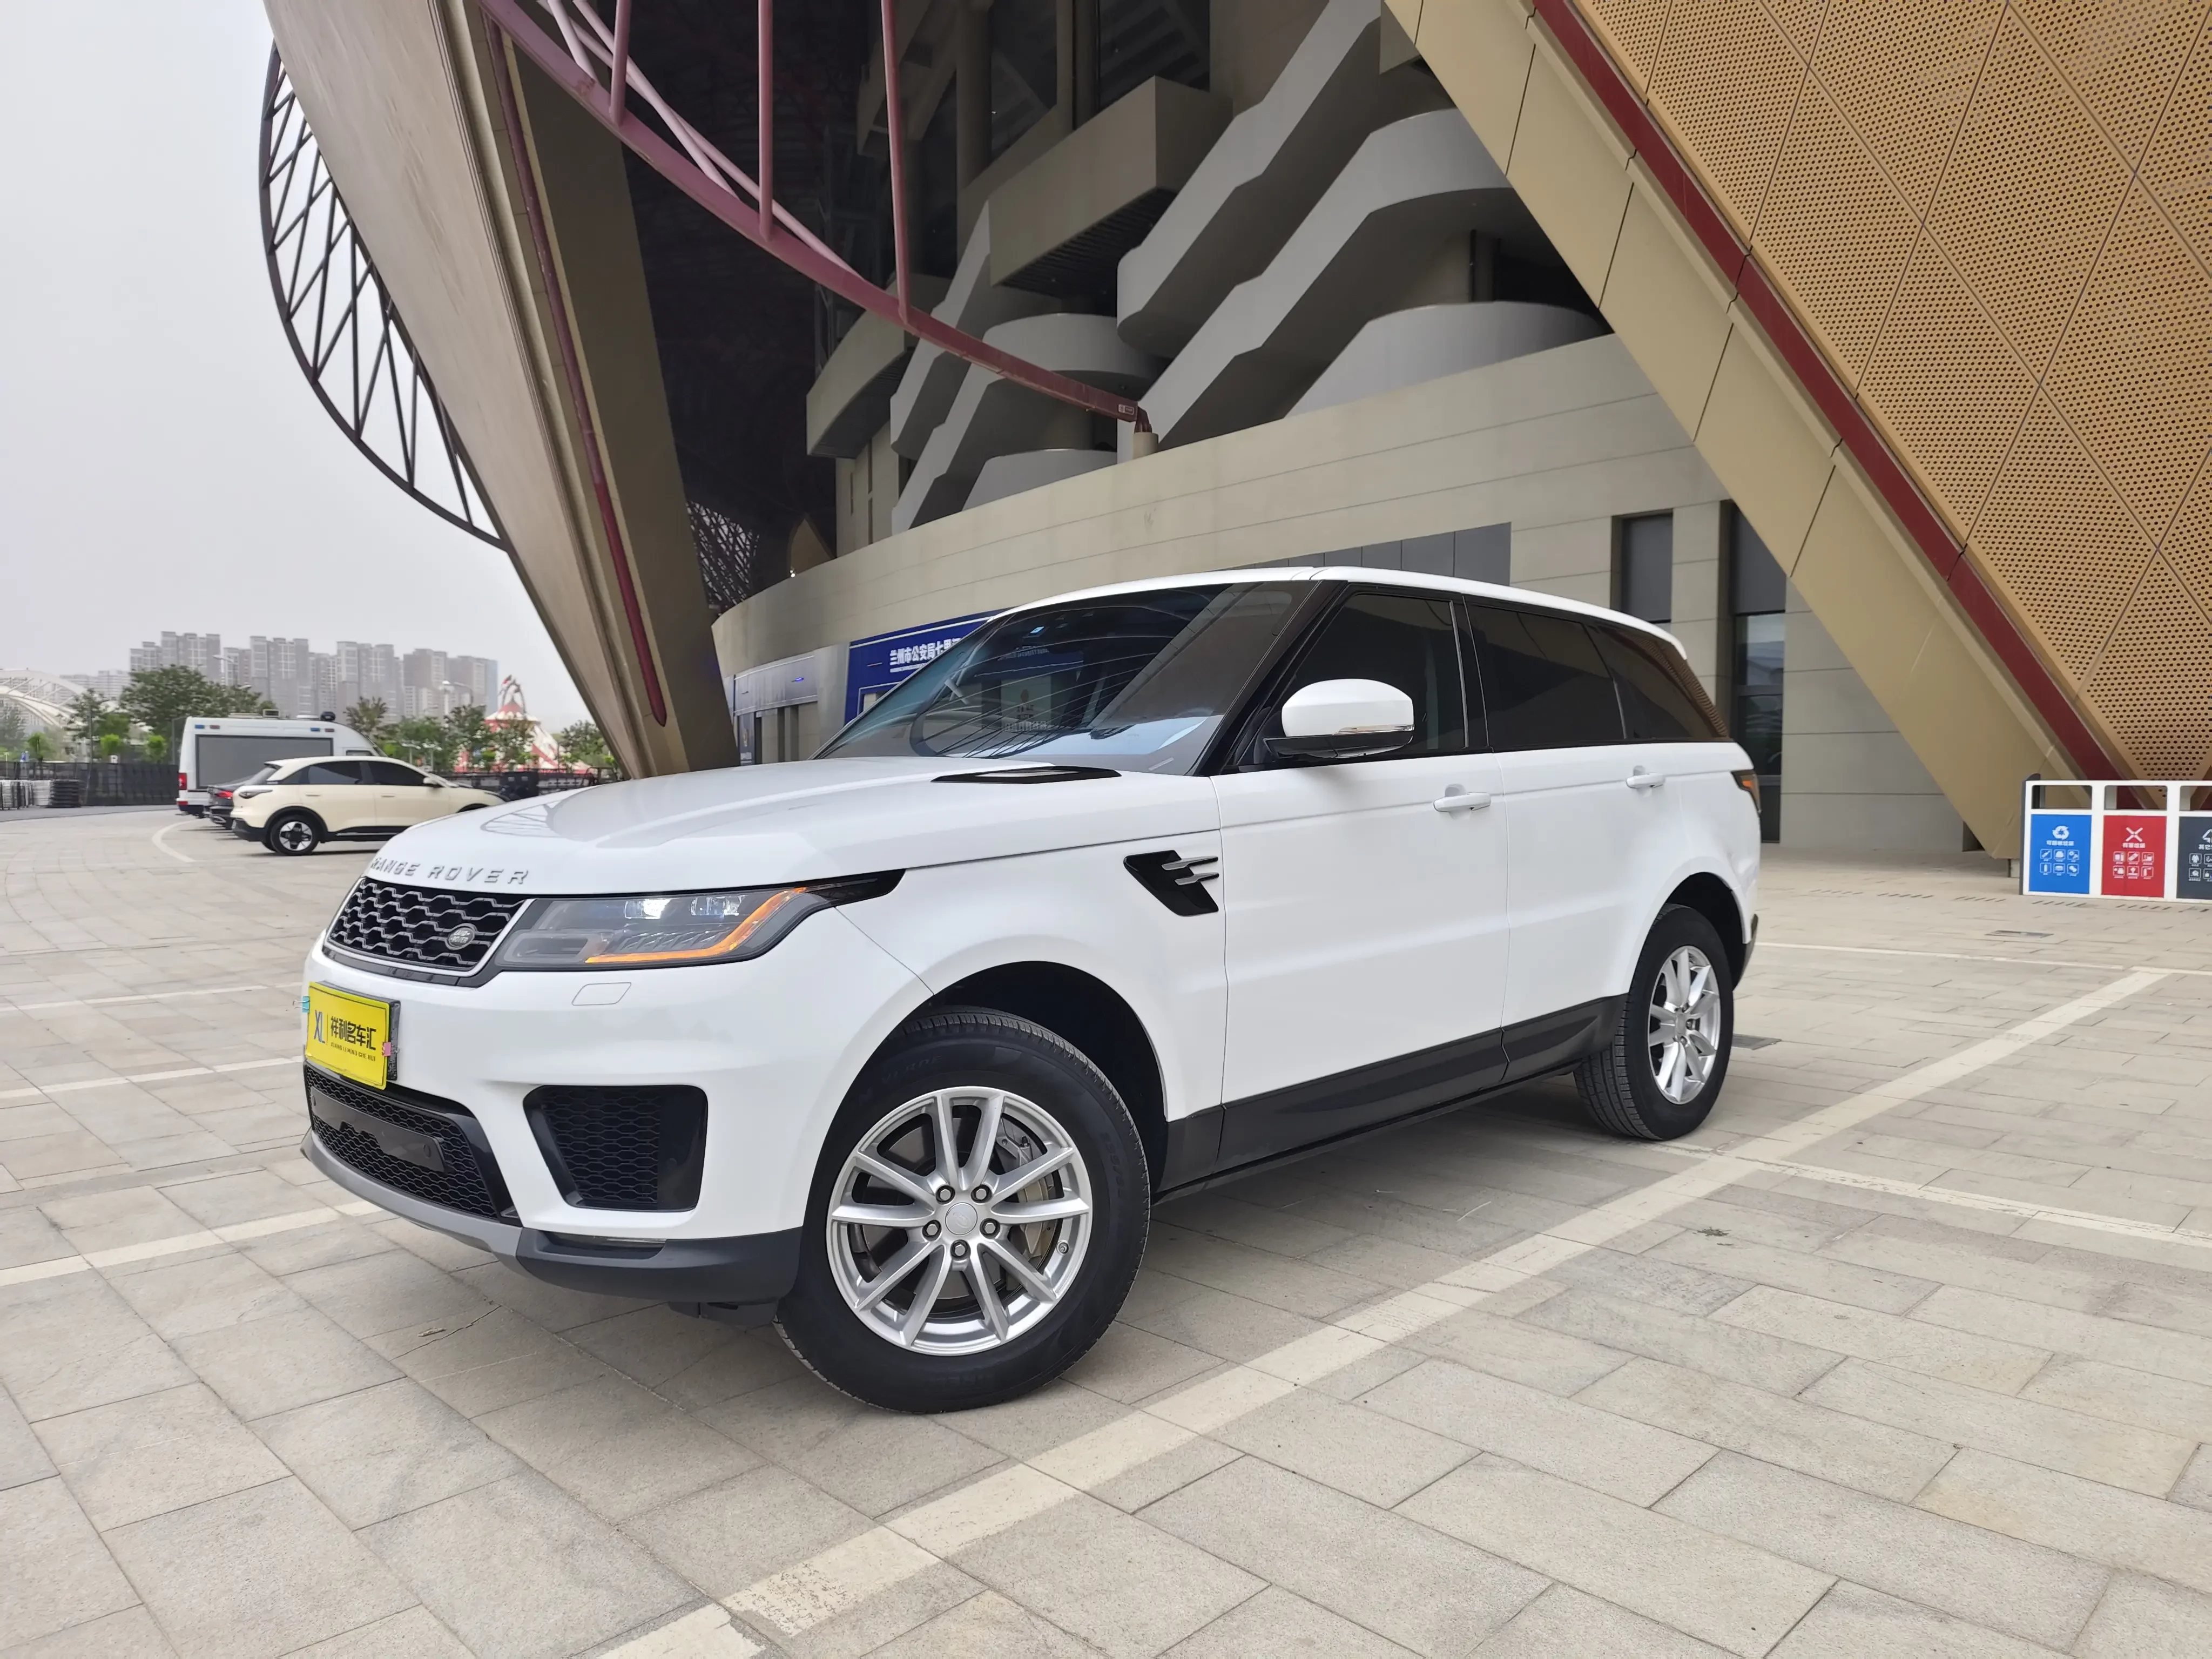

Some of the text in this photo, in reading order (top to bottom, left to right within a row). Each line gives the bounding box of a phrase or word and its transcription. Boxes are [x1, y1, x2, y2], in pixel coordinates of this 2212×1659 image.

[427, 865, 529, 885] ROVER
[331, 1016, 377, 1051] 祥利名车汇
[331, 1042, 342, 1050] XIANG
